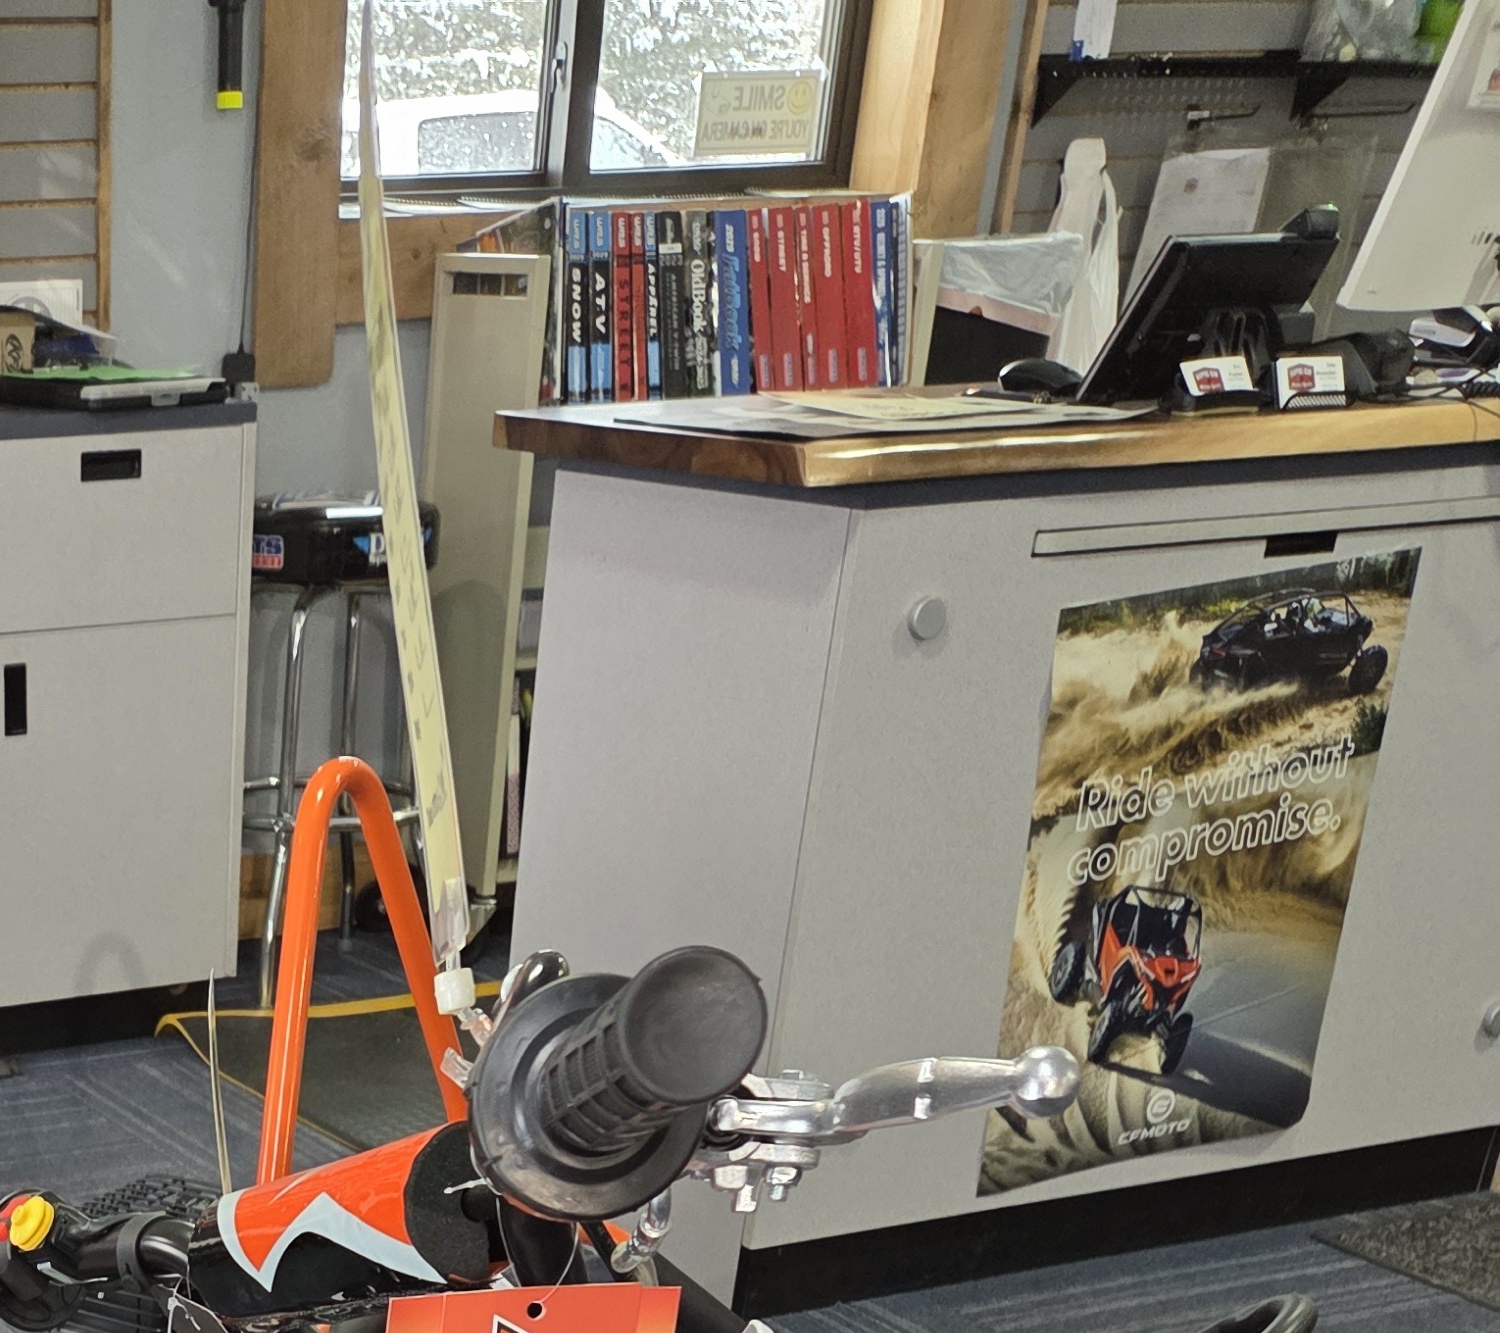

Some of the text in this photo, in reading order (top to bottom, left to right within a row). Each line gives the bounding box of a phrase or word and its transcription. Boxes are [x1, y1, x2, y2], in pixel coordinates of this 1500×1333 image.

[572, 267, 582, 343] SNOW
[595, 272, 606, 334] ATV
[691, 258, 707, 334] OldBook
[722, 253, 742, 351] FatBook
[1076, 733, 1357, 833] Ride without
[1066, 797, 1343, 888] compromise.
[1118, 1118, 1193, 1146] CFMOTO
